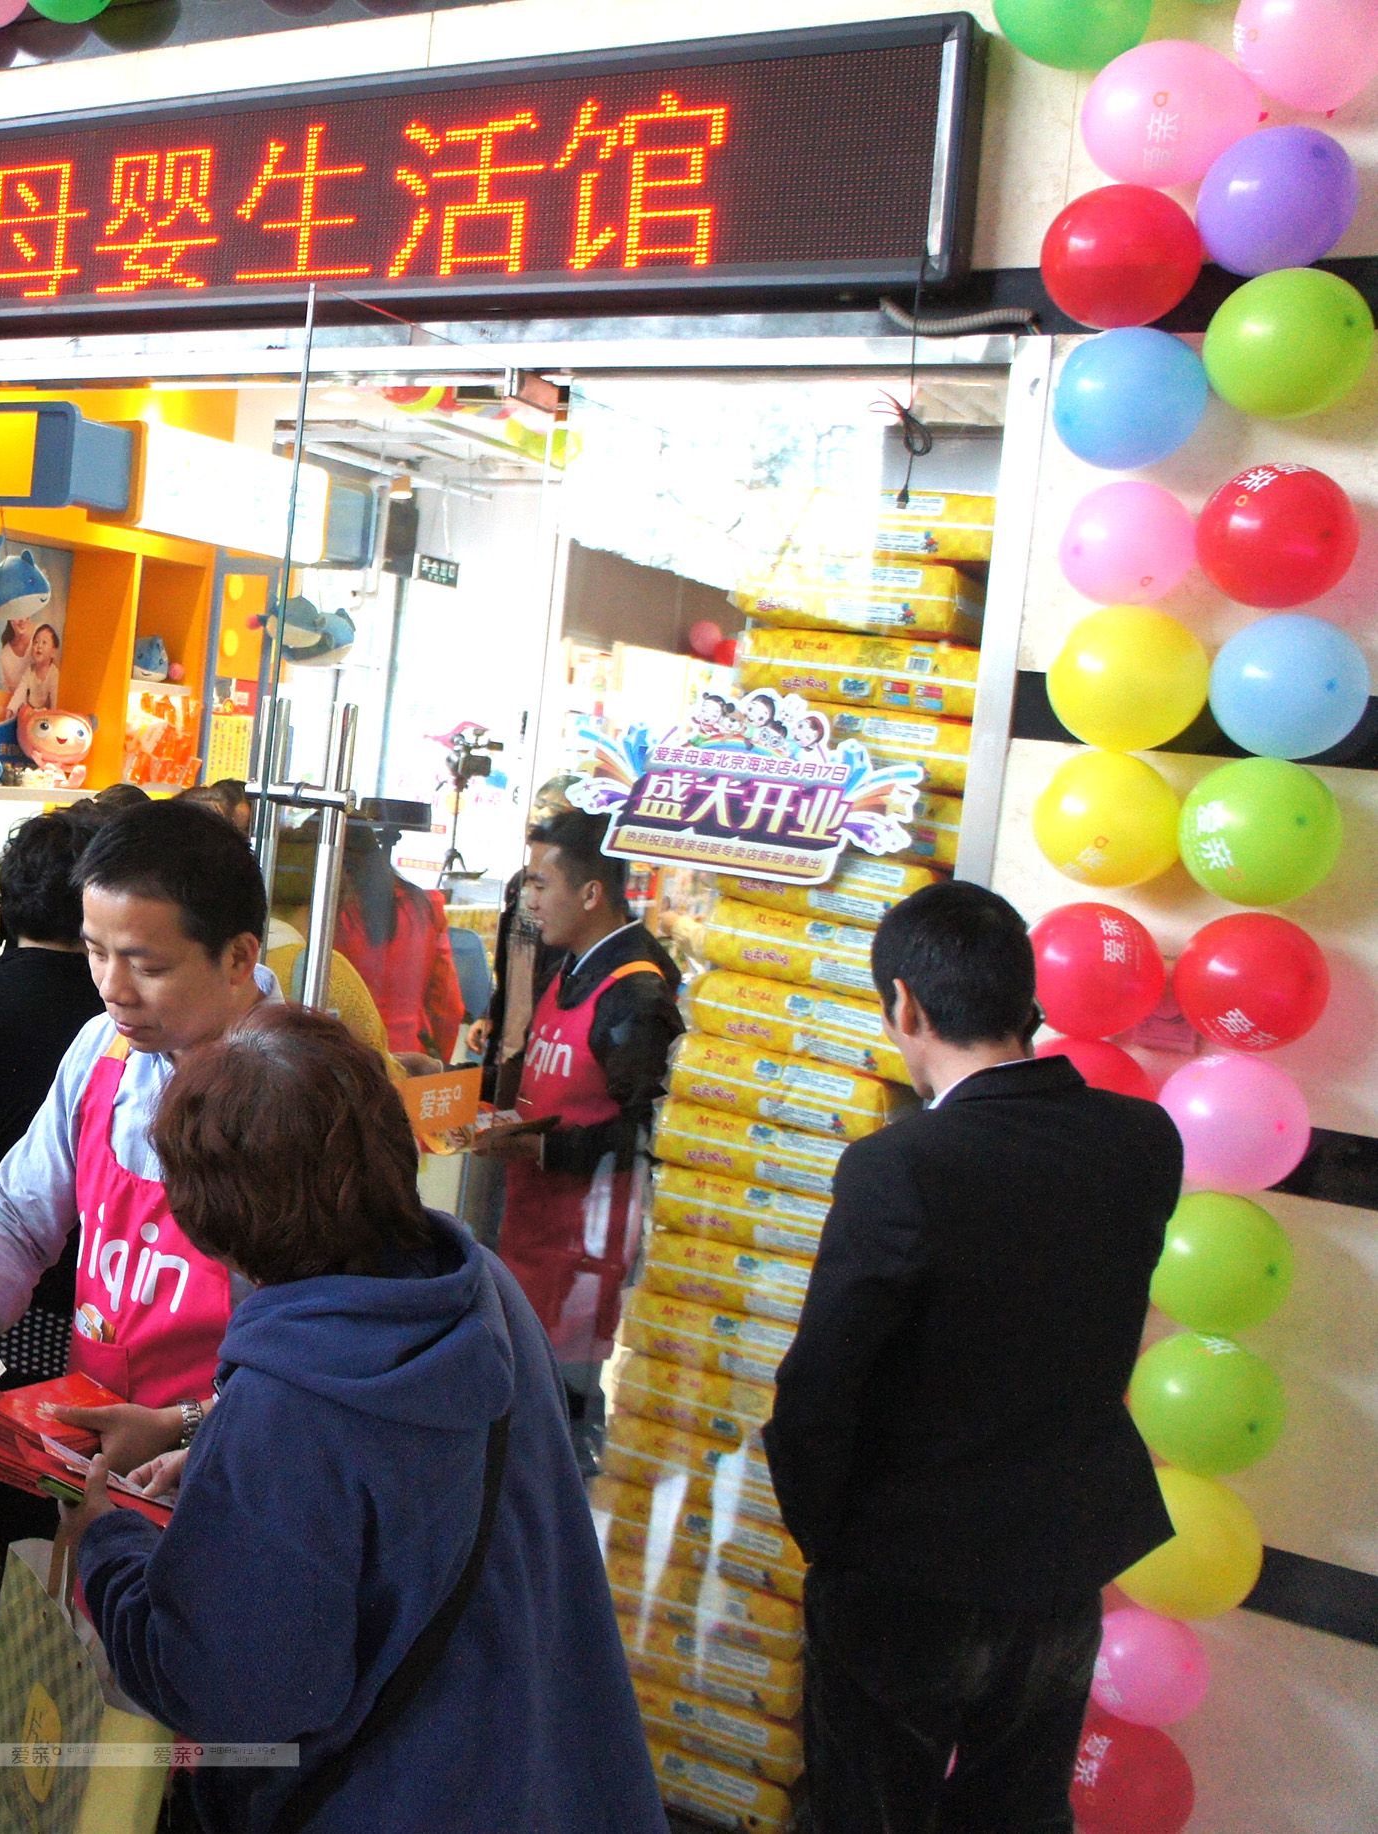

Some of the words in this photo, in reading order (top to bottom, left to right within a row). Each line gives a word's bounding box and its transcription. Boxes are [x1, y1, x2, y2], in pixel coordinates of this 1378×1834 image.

[655, 747, 847, 781] 爱亲母婴北京海淀店4月17日
[634, 771, 850, 841] 盛大开业
[1100, 916, 1126, 964] 爱亲
[420, 1088, 450, 1120] 爱亲
